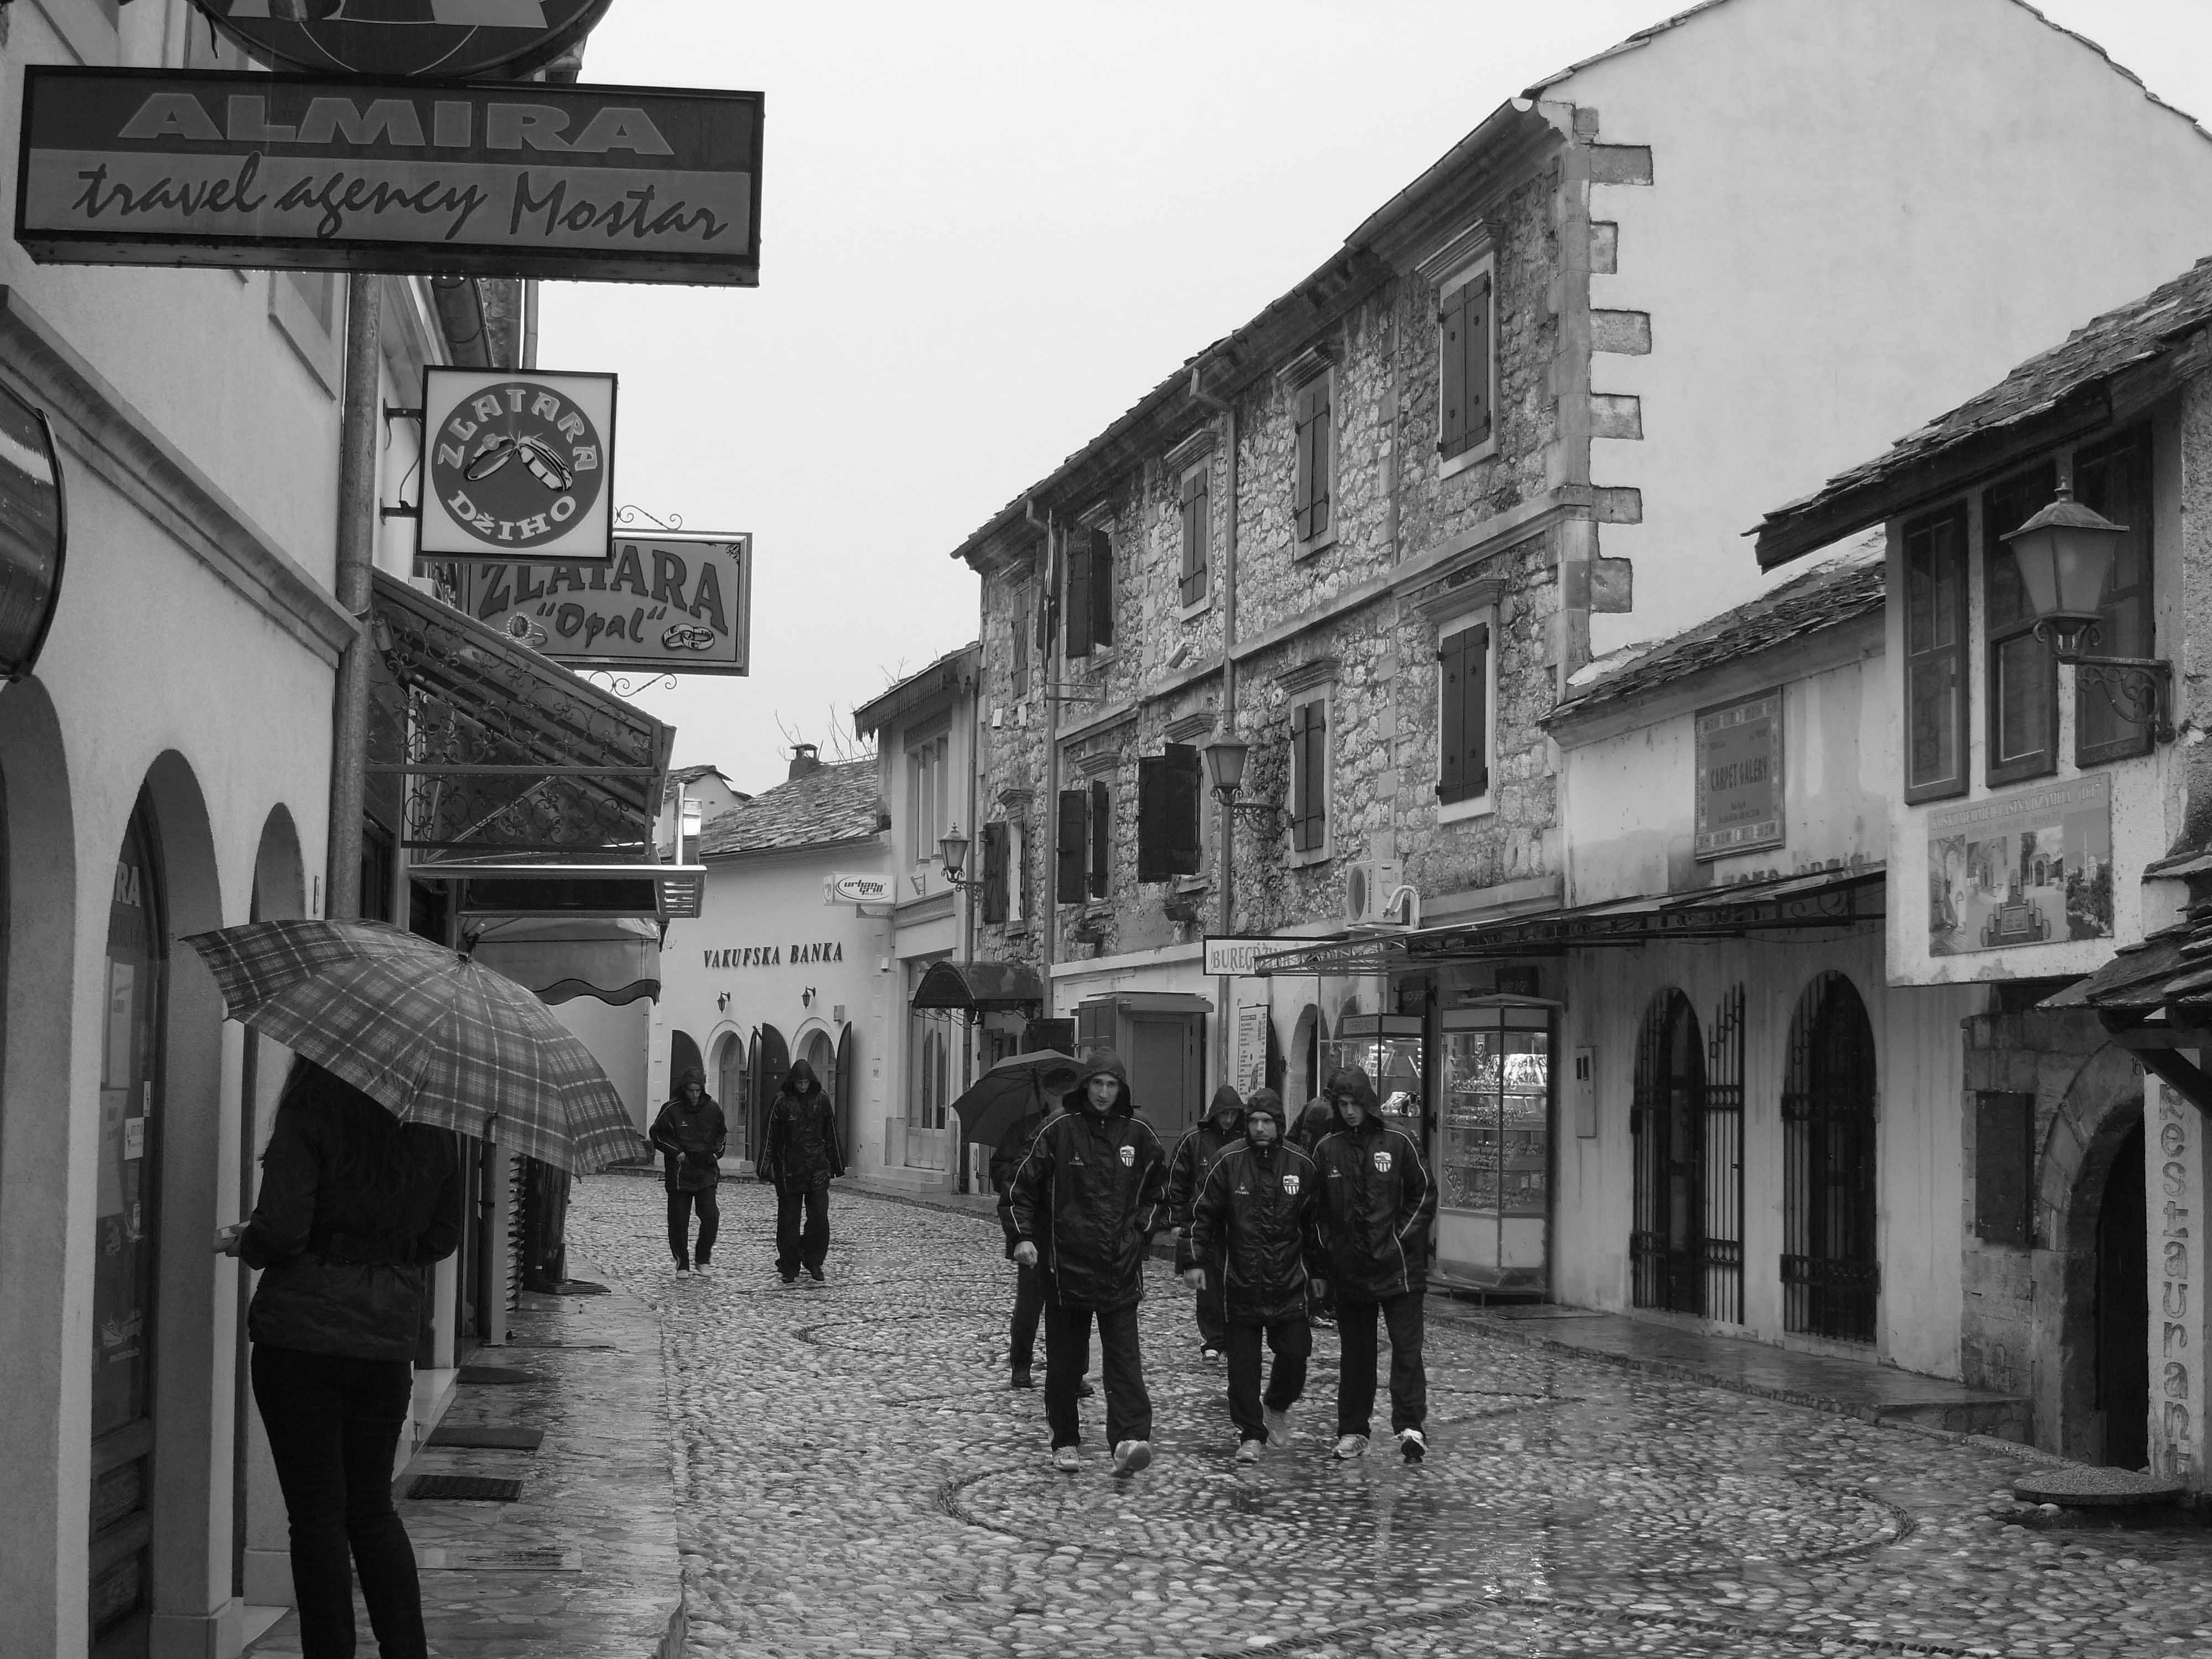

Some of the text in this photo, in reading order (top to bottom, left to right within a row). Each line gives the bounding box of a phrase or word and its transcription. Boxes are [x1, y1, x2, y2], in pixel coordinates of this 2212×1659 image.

[118, 92, 674, 155] ALMIRA
[72, 151, 728, 241] travel agency Mostar
[437, 389, 597, 471] ZLATARA
[448, 490, 576, 540] DŽIHO
[1711, 762, 1738, 792] CARPET
[703, 942, 843, 968] VAKUFSKA BANKA
